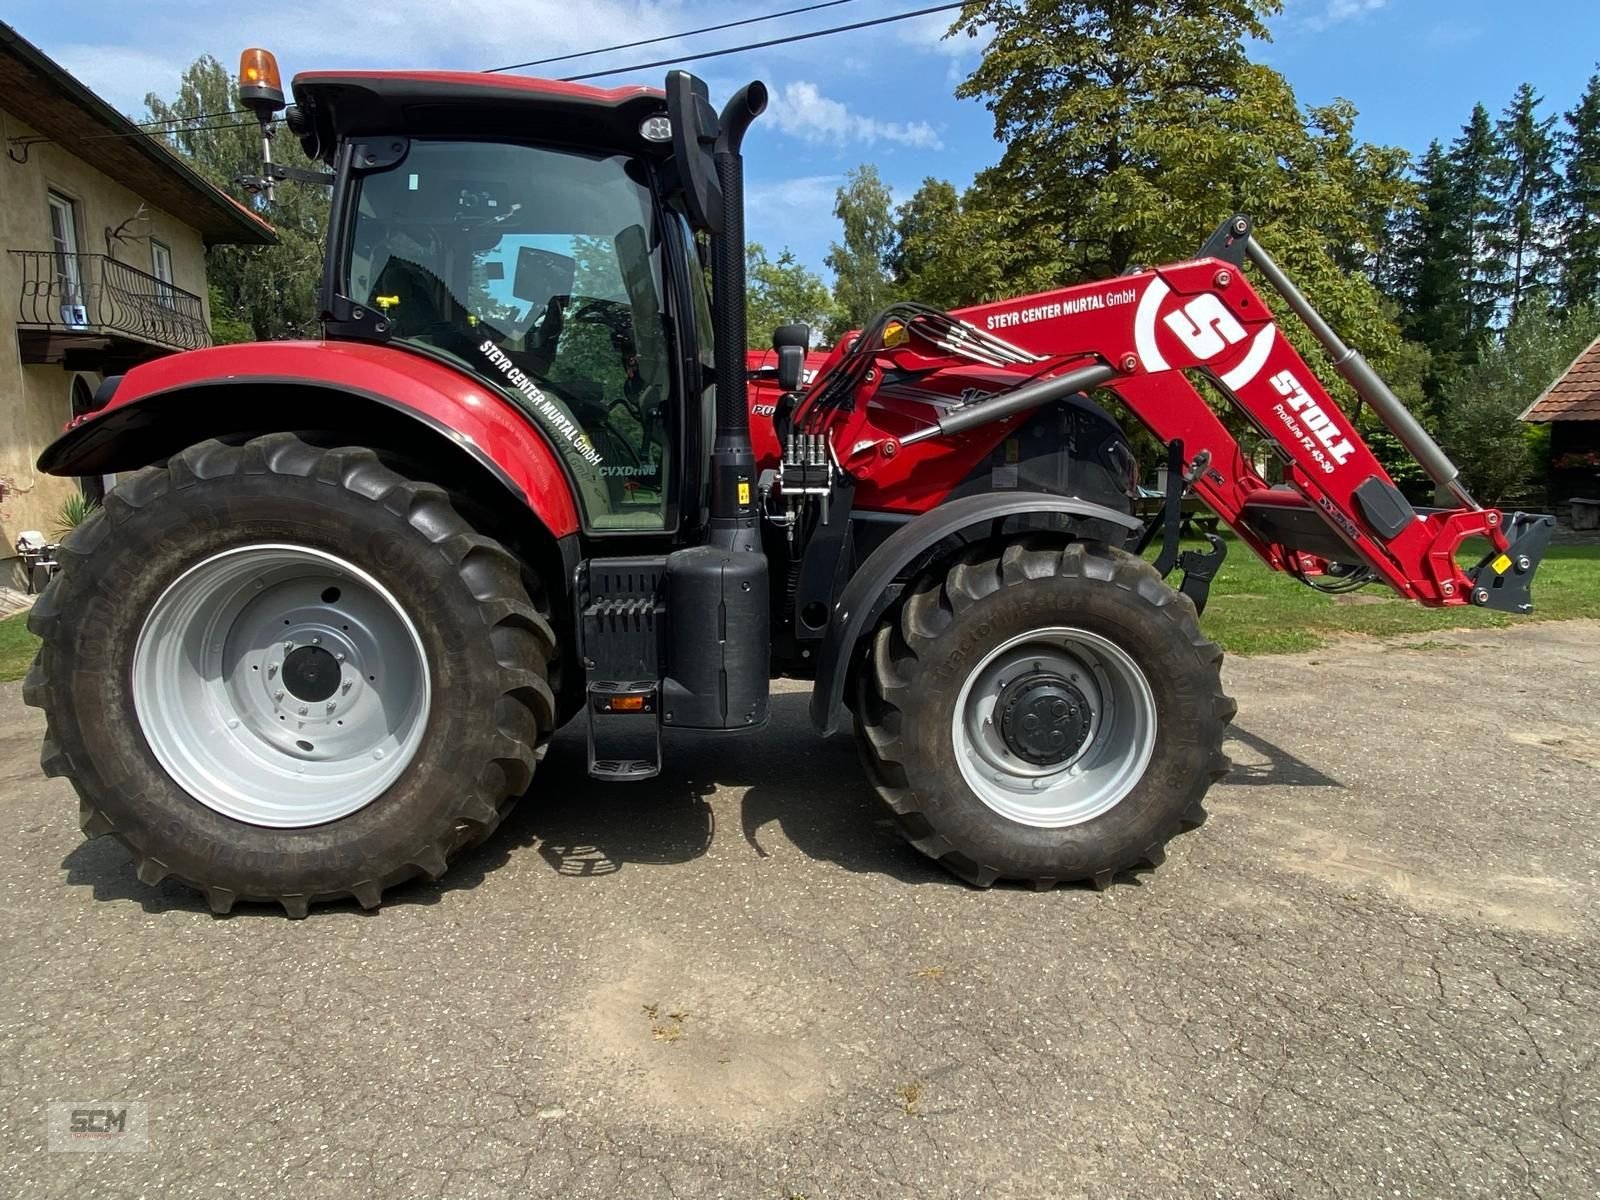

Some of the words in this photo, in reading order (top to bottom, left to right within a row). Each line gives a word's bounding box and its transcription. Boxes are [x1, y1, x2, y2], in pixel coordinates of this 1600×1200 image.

[987, 312, 1020, 329] STEYR
[1021, 304, 1061, 323] CENTER
[1063, 295, 1105, 315] MURTAL
[1106, 289, 1136, 307] GmbH
[479, 340, 513, 373] STEYR
[507, 368, 546, 406] CENTER
[539, 401, 578, 441] MURTAL
[573, 434, 603, 466] GmbH
[752, 404, 776, 416] PU
[1269, 369, 1356, 465] STOLL
[1273, 404, 1303, 438] ProfiLine
[1300, 436, 1316, 451] FZ
[1312, 449, 1335, 474] 43-30
